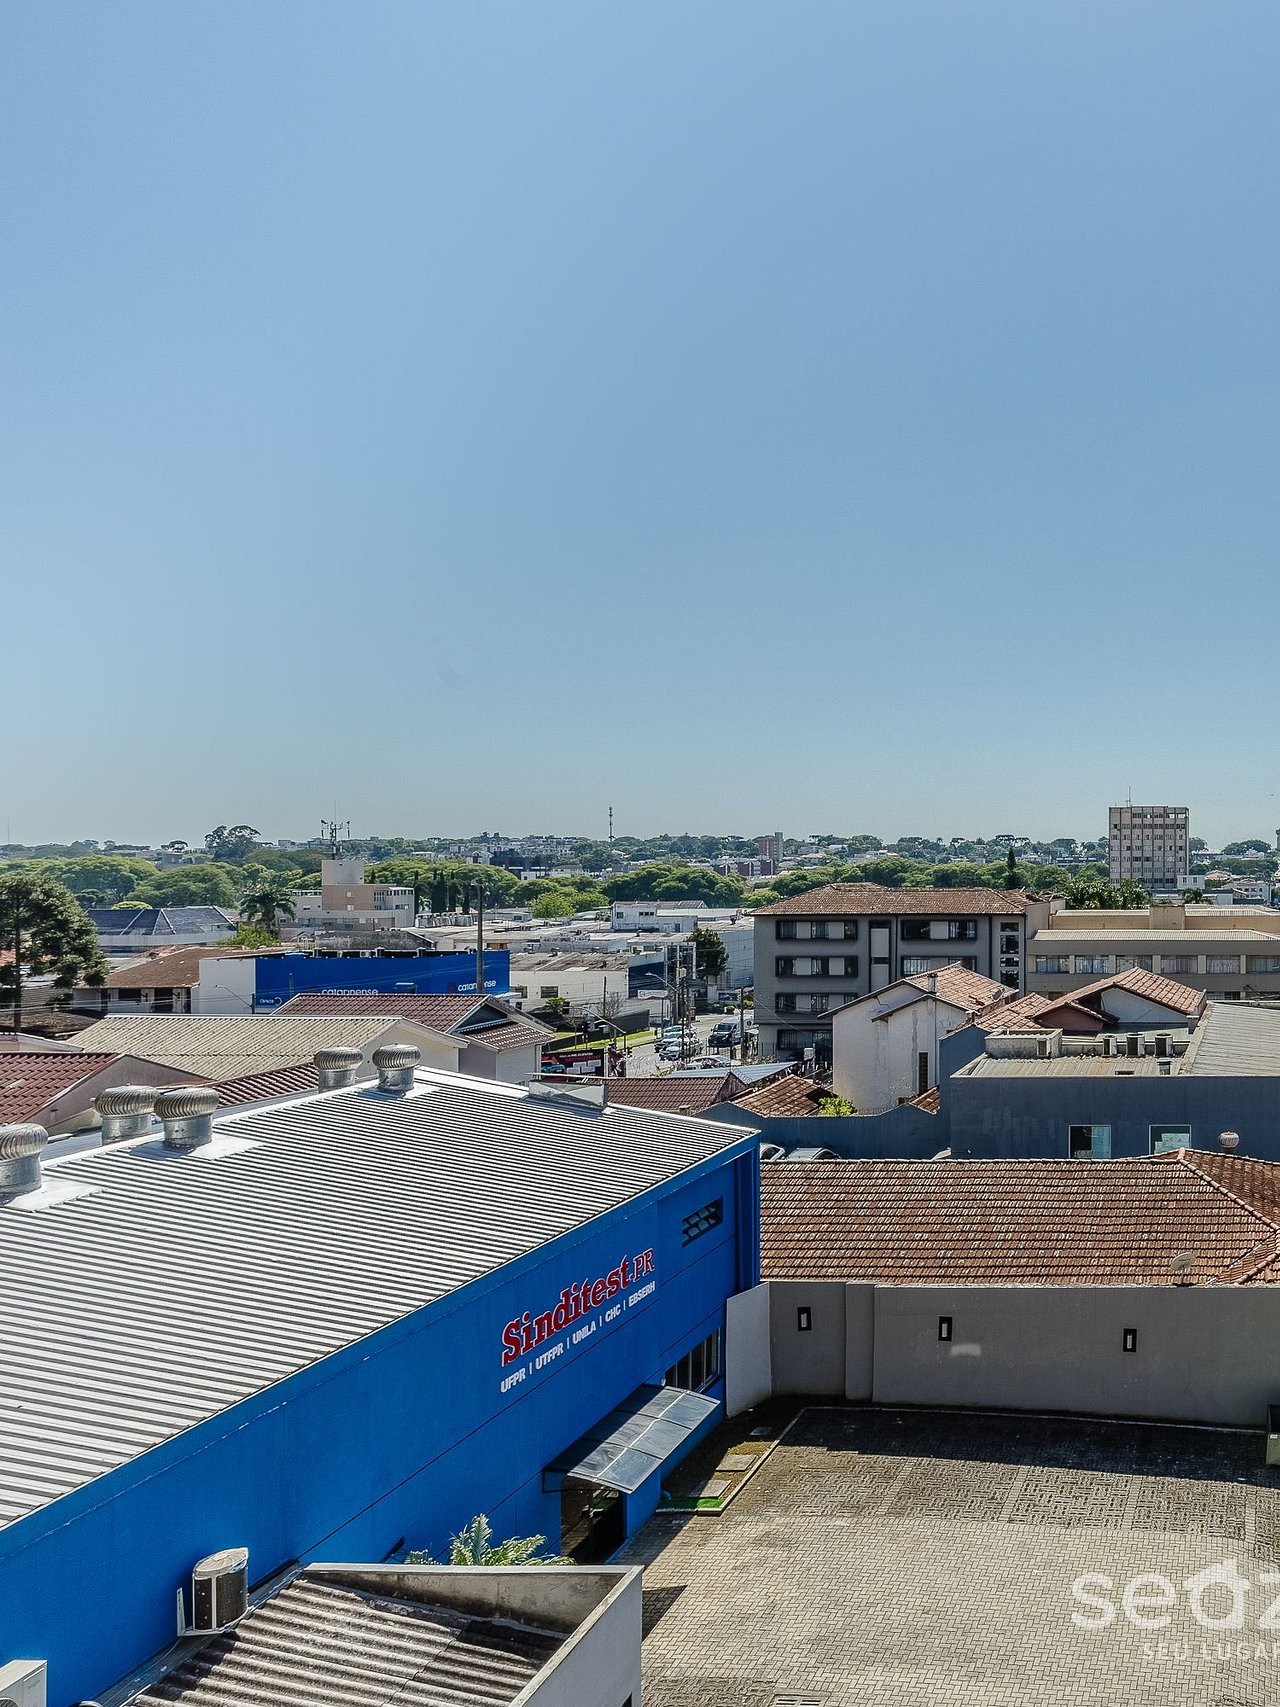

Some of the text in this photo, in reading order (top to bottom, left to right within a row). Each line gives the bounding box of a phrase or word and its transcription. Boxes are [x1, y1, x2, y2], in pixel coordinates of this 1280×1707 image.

[457, 980, 497, 991] catarinse
[501, 1281, 655, 1392] UFPR UTFPR UNILA CHC EBSERH
